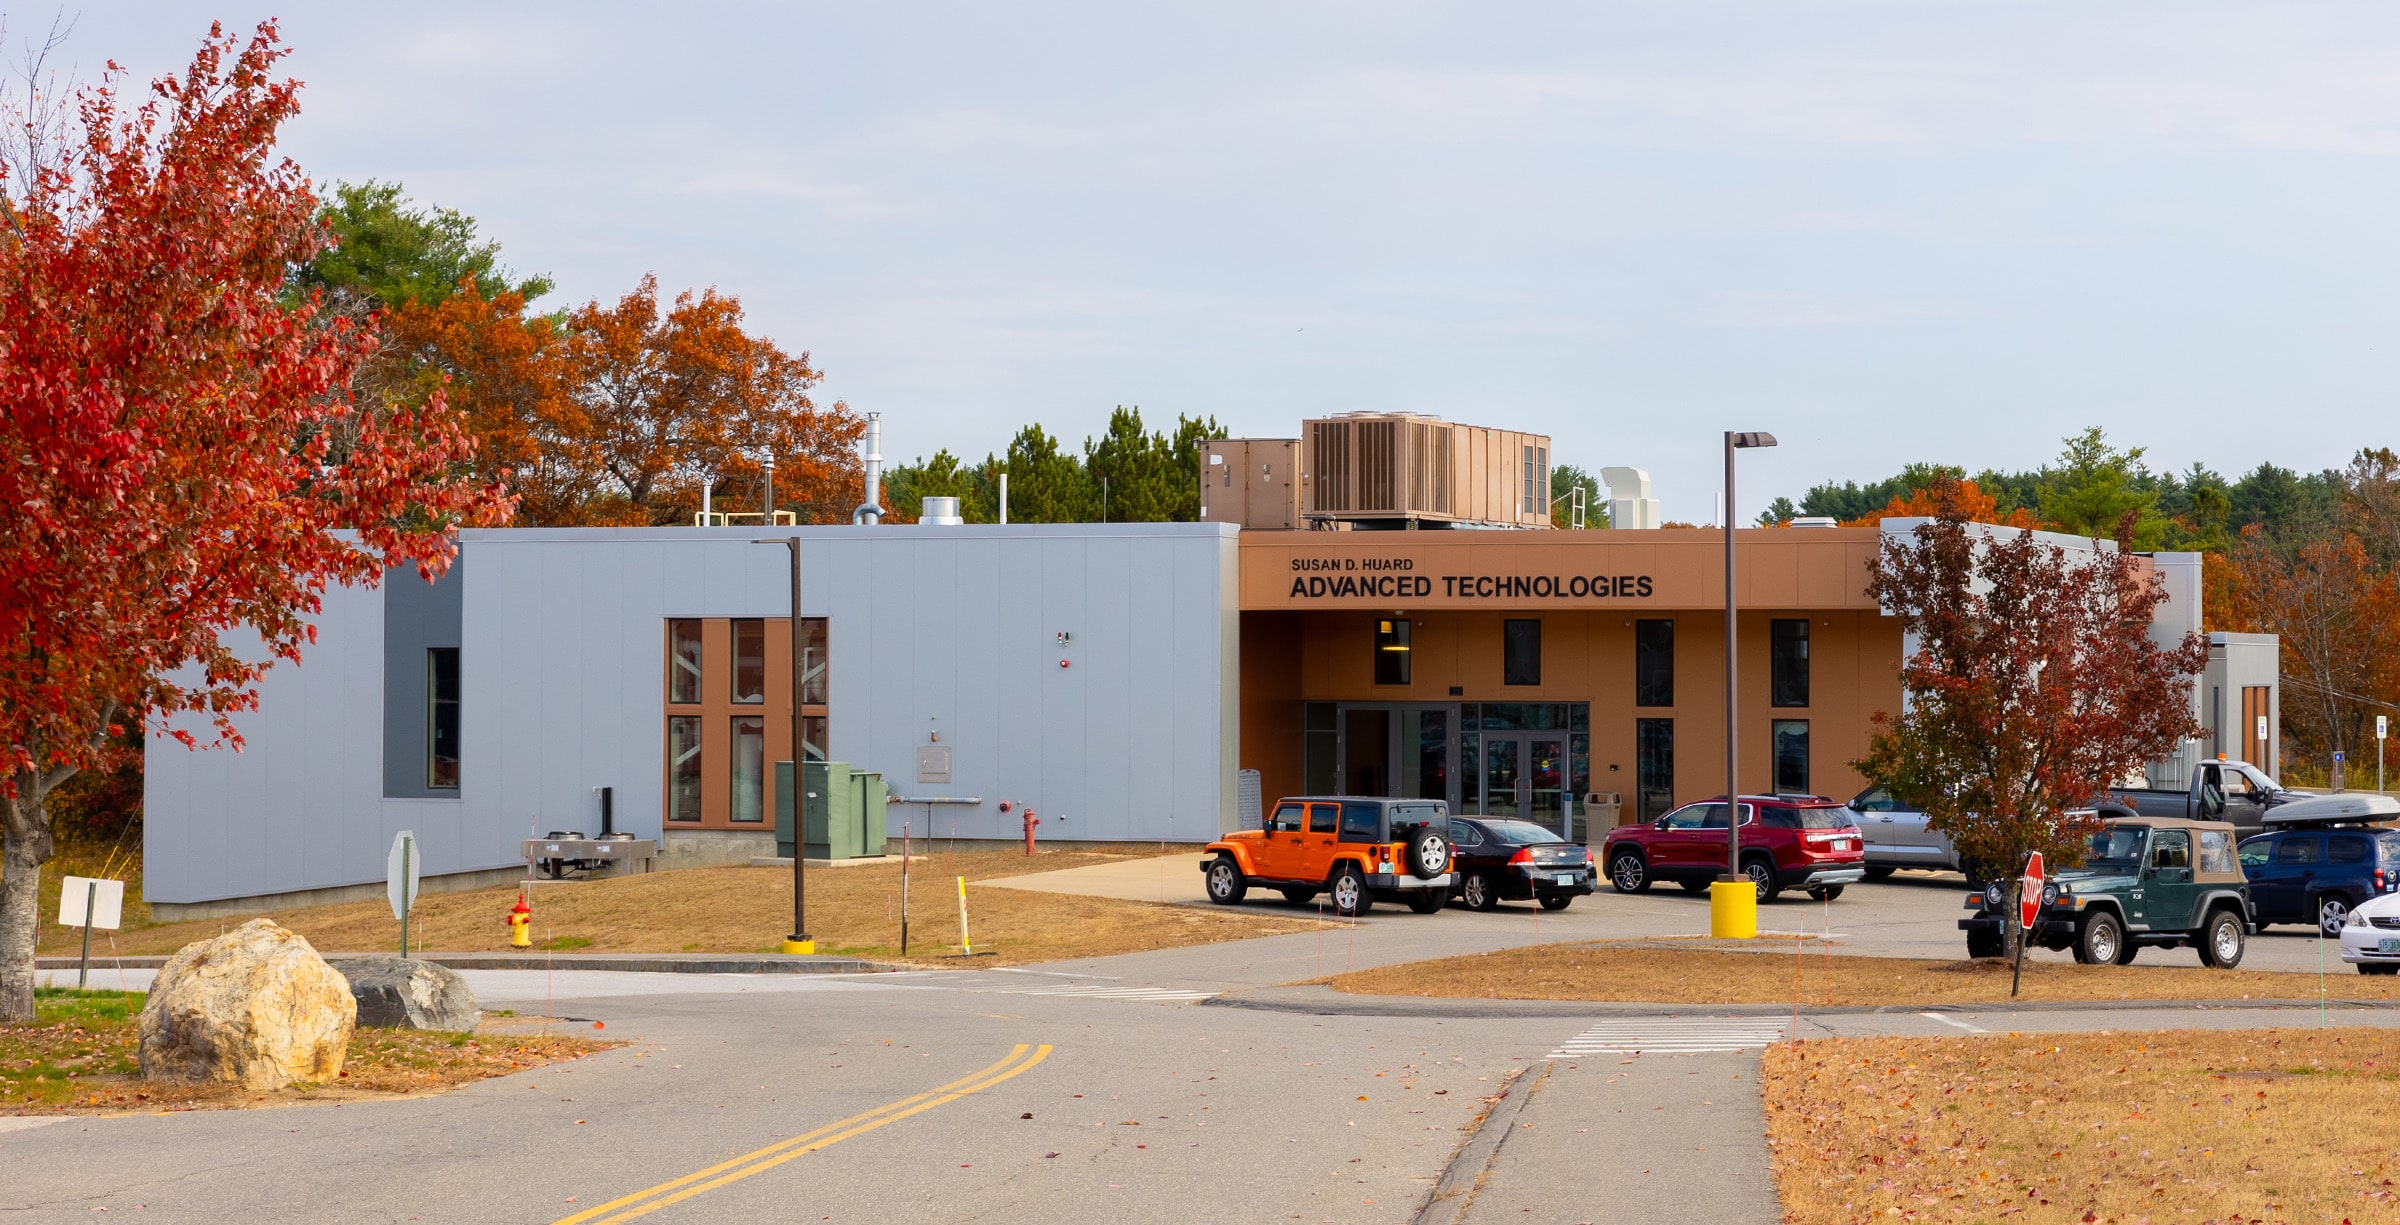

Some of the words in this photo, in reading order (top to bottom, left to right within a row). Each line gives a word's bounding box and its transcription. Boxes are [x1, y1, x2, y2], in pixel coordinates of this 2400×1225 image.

[1291, 558, 1341, 571] SUSAN
[1345, 558, 1358, 571] D.
[1362, 558, 1414, 571] HUARD
[1289, 575, 1432, 598] ADVANCED
[1441, 575, 1653, 598] TECHNOLOGIES
[2023, 875, 2042, 905] STOP
